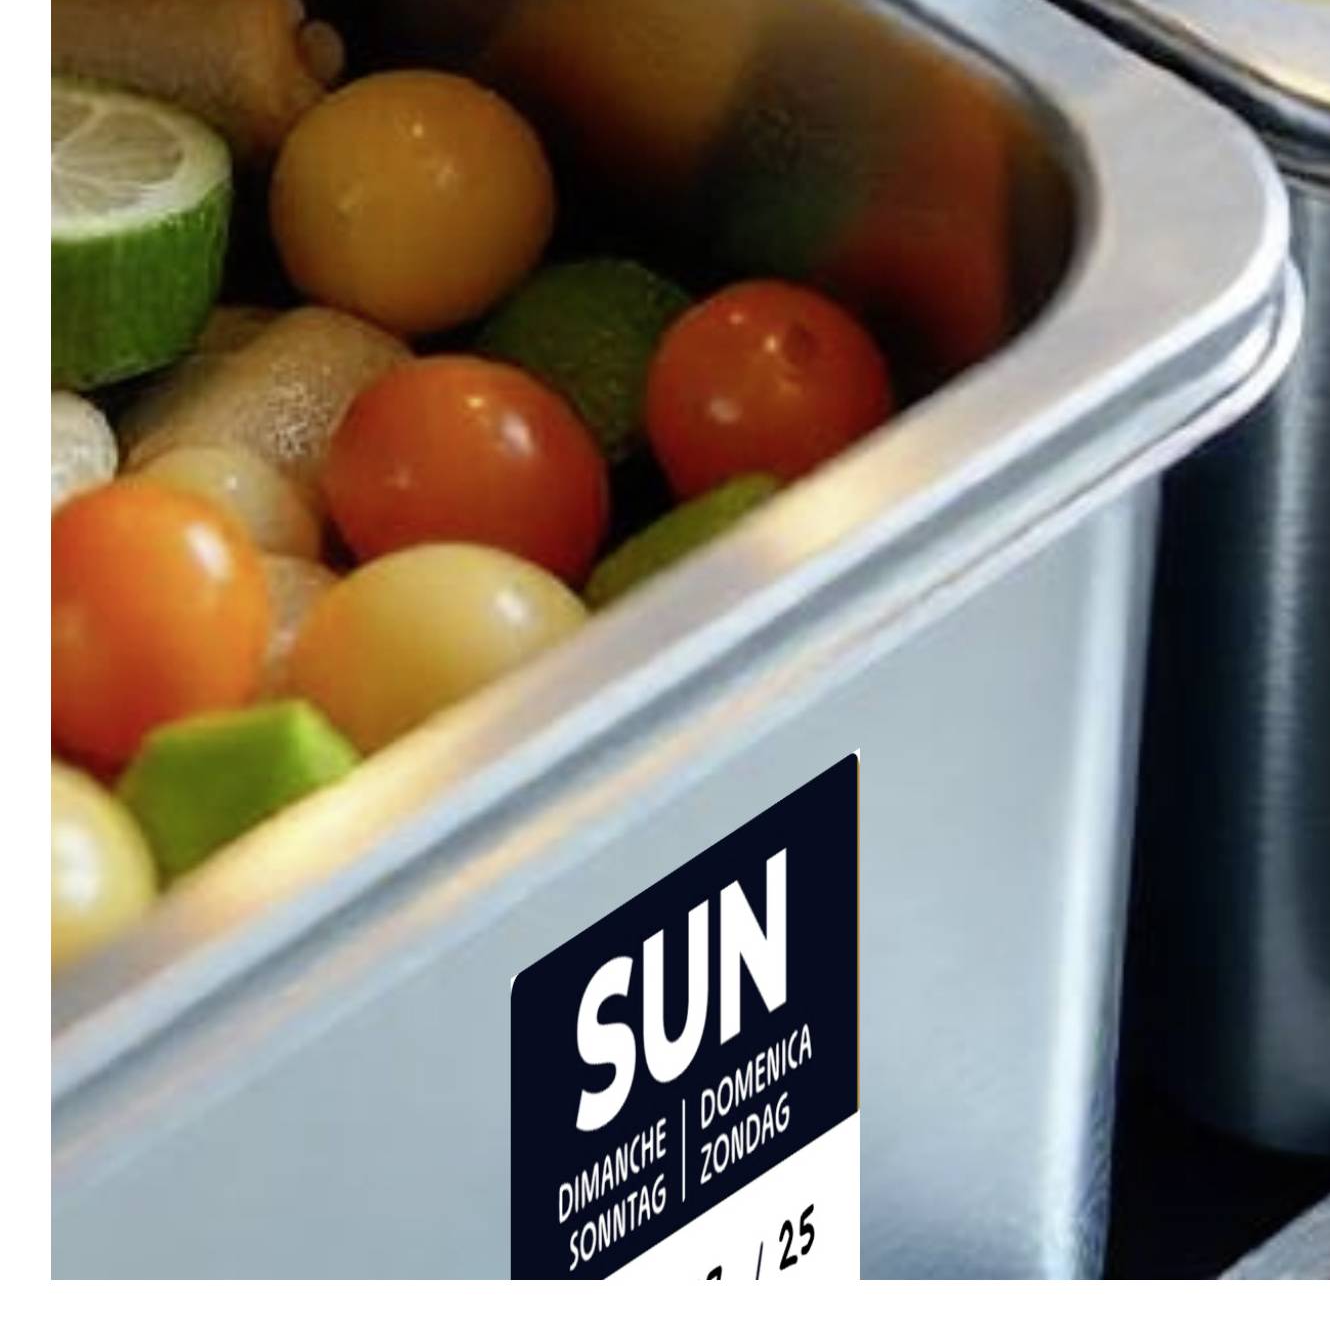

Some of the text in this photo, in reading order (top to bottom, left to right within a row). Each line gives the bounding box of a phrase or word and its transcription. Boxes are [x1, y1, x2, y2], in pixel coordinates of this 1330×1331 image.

[575, 848, 787, 1132] SUN
[700, 1023, 812, 1130] DOMENICA
[558, 1117, 667, 1224] DIMANCHE
[700, 1091, 790, 1185] ZONDAG
[569, 1173, 667, 1271] SONNTAG
[778, 1203, 815, 1271] 25
